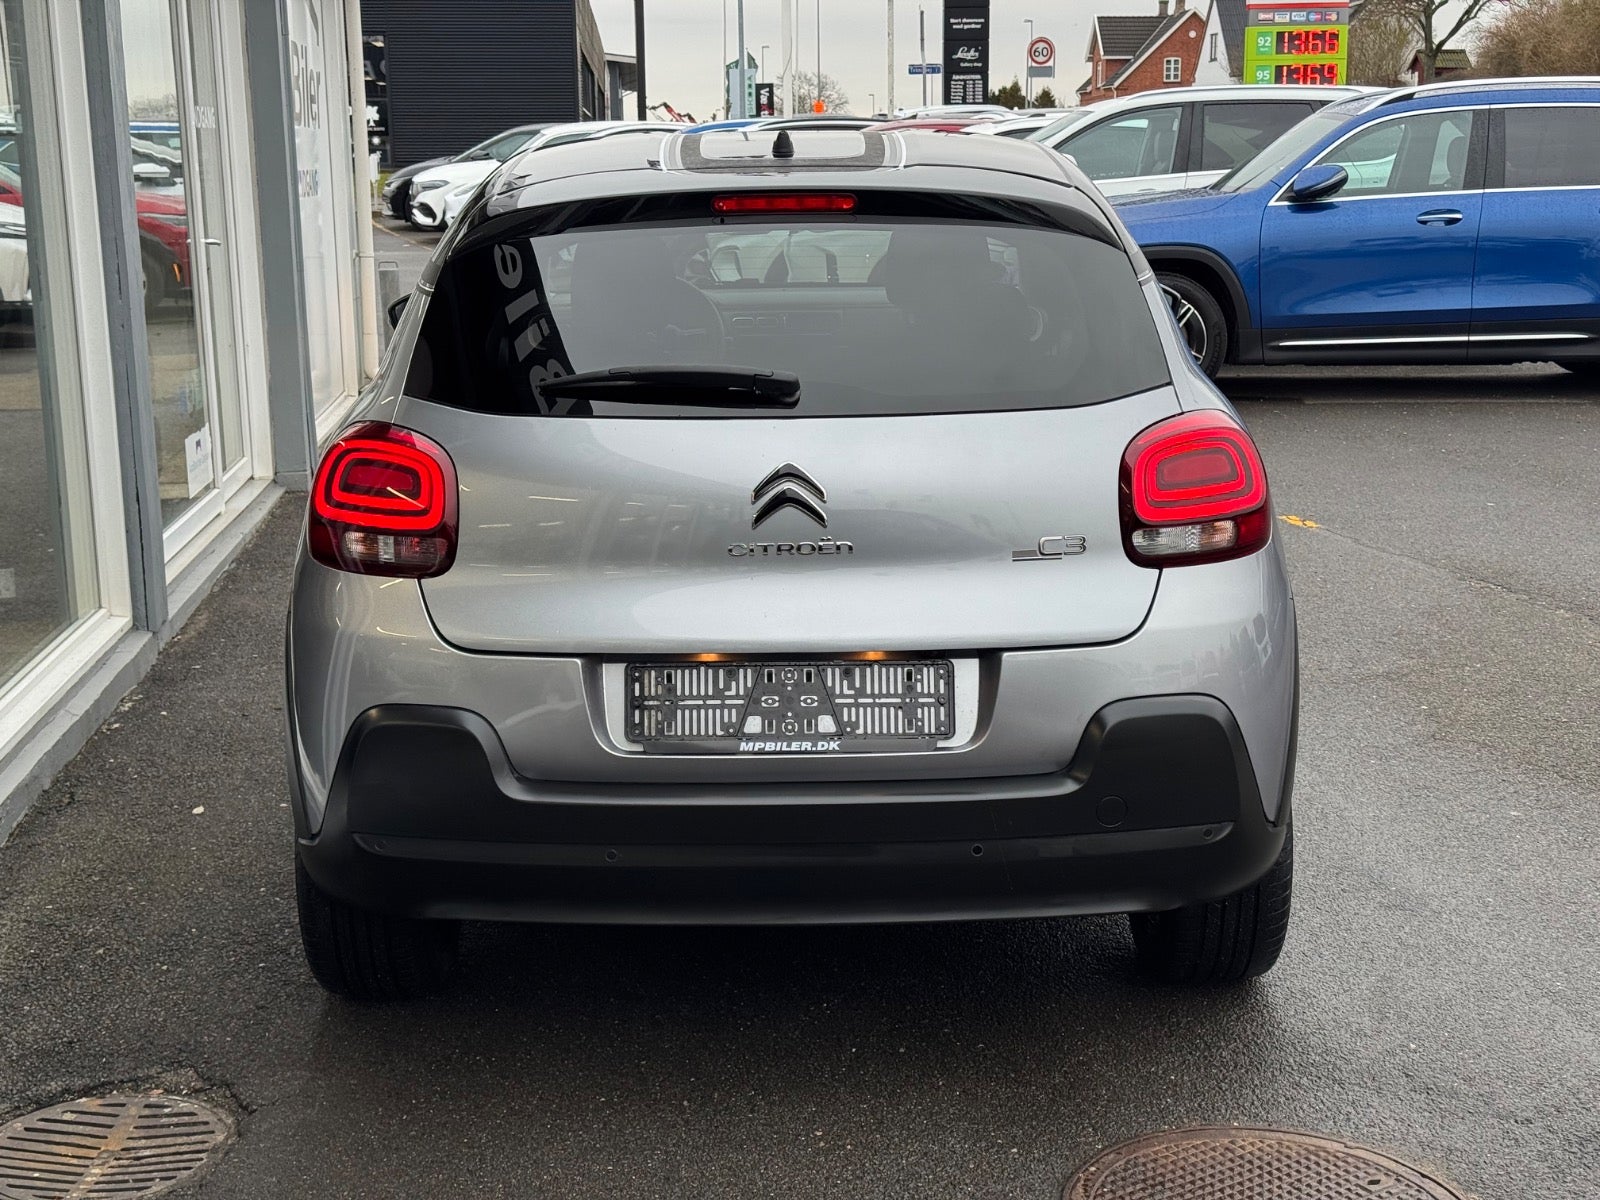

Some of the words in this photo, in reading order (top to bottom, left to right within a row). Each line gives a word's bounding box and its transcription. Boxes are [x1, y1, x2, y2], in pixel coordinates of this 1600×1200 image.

[1257, 36, 1272, 47] 92
[1033, 46, 1049, 58] 60
[1256, 70, 1271, 81] 95
[290, 40, 321, 130] Biler
[1038, 534, 1088, 556] C3
[739, 740, 841, 752] MPBILER.DK
